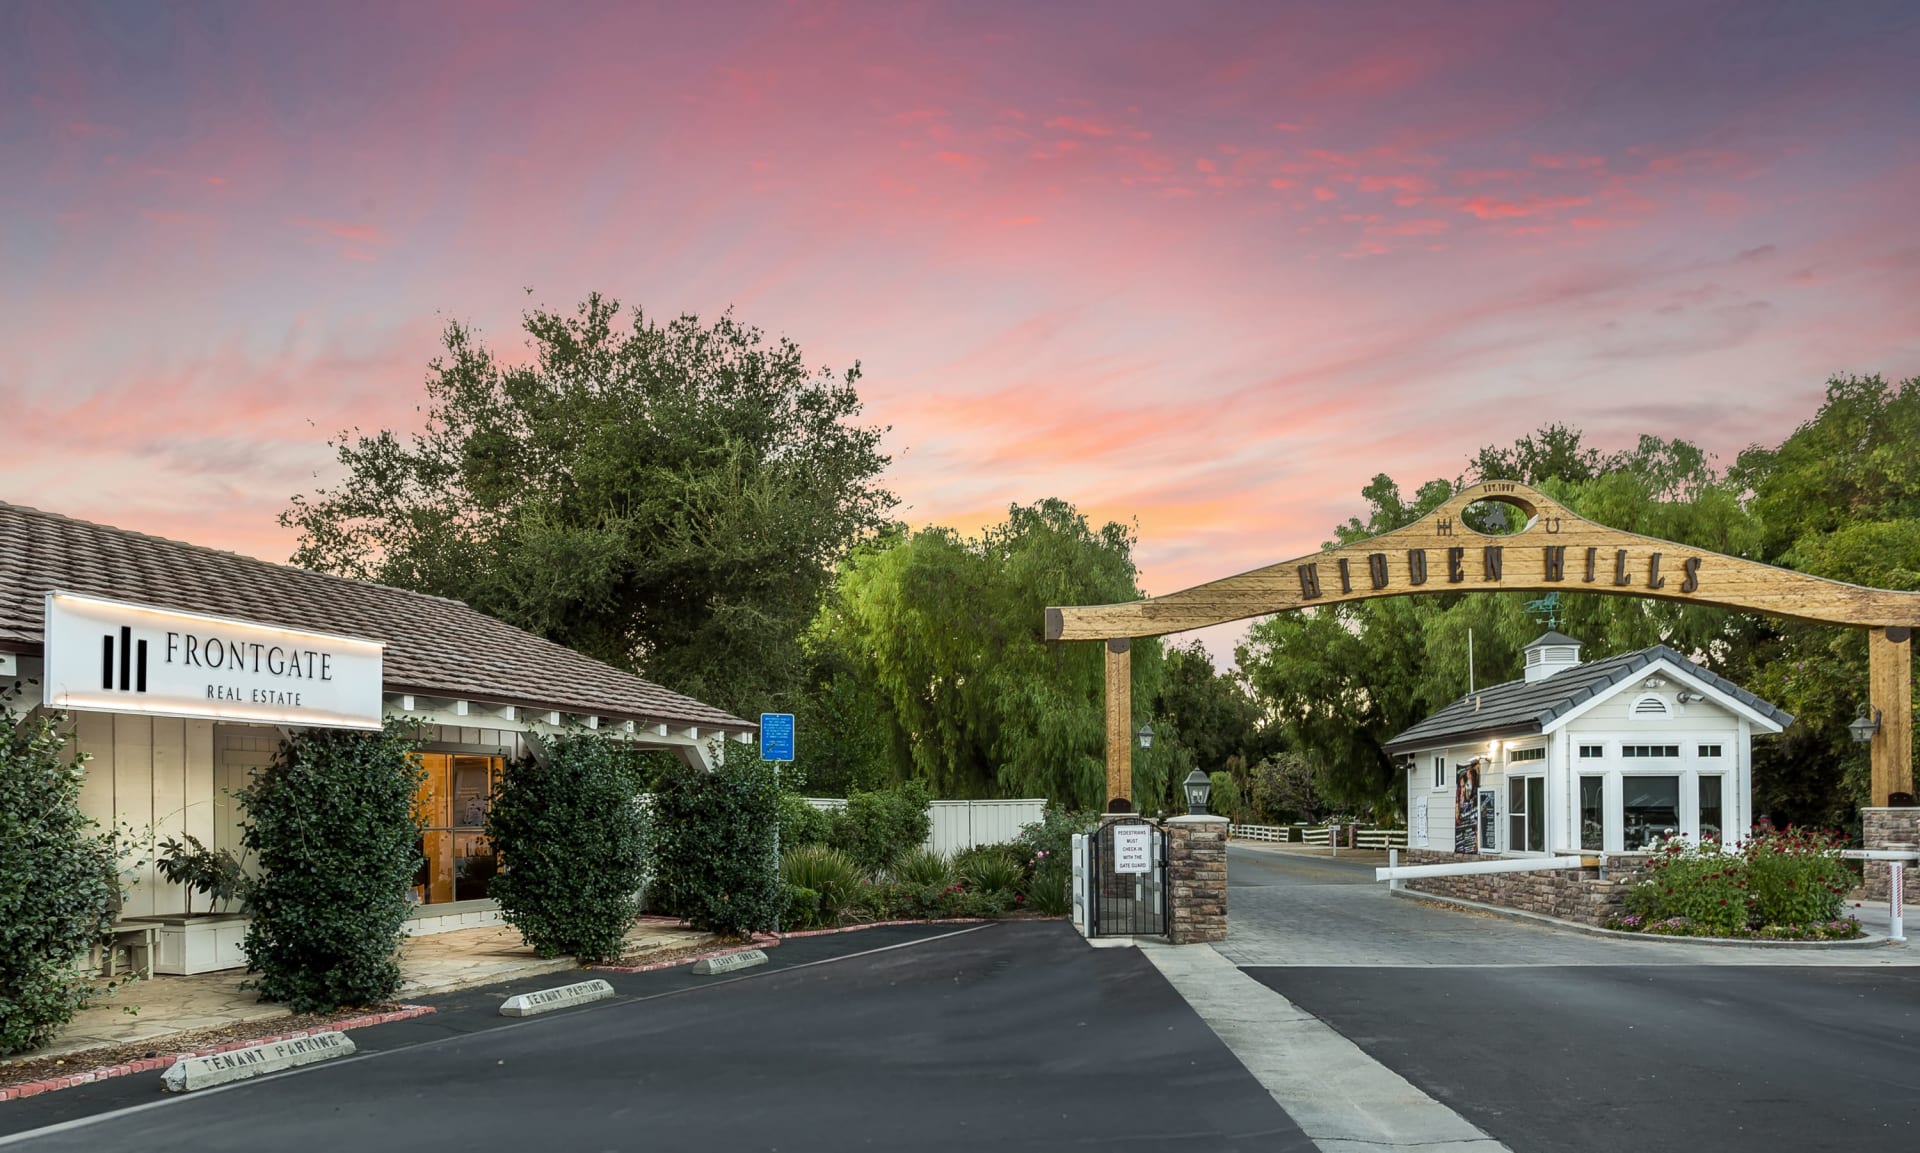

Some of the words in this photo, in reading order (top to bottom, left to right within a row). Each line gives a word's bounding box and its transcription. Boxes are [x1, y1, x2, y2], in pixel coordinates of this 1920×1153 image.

[1298, 545, 1504, 600] HIDDEN
[1544, 545, 1702, 594] HILLS
[166, 632, 333, 681] FRONTGATE
[207, 684, 242, 701] REAL
[253, 689, 301, 706] ESTATE
[526, 989, 562, 1005] TENANT
[566, 981, 605, 998] PARKING
[202, 1048, 266, 1072] TENANT
[275, 1034, 340, 1057] PARKING
